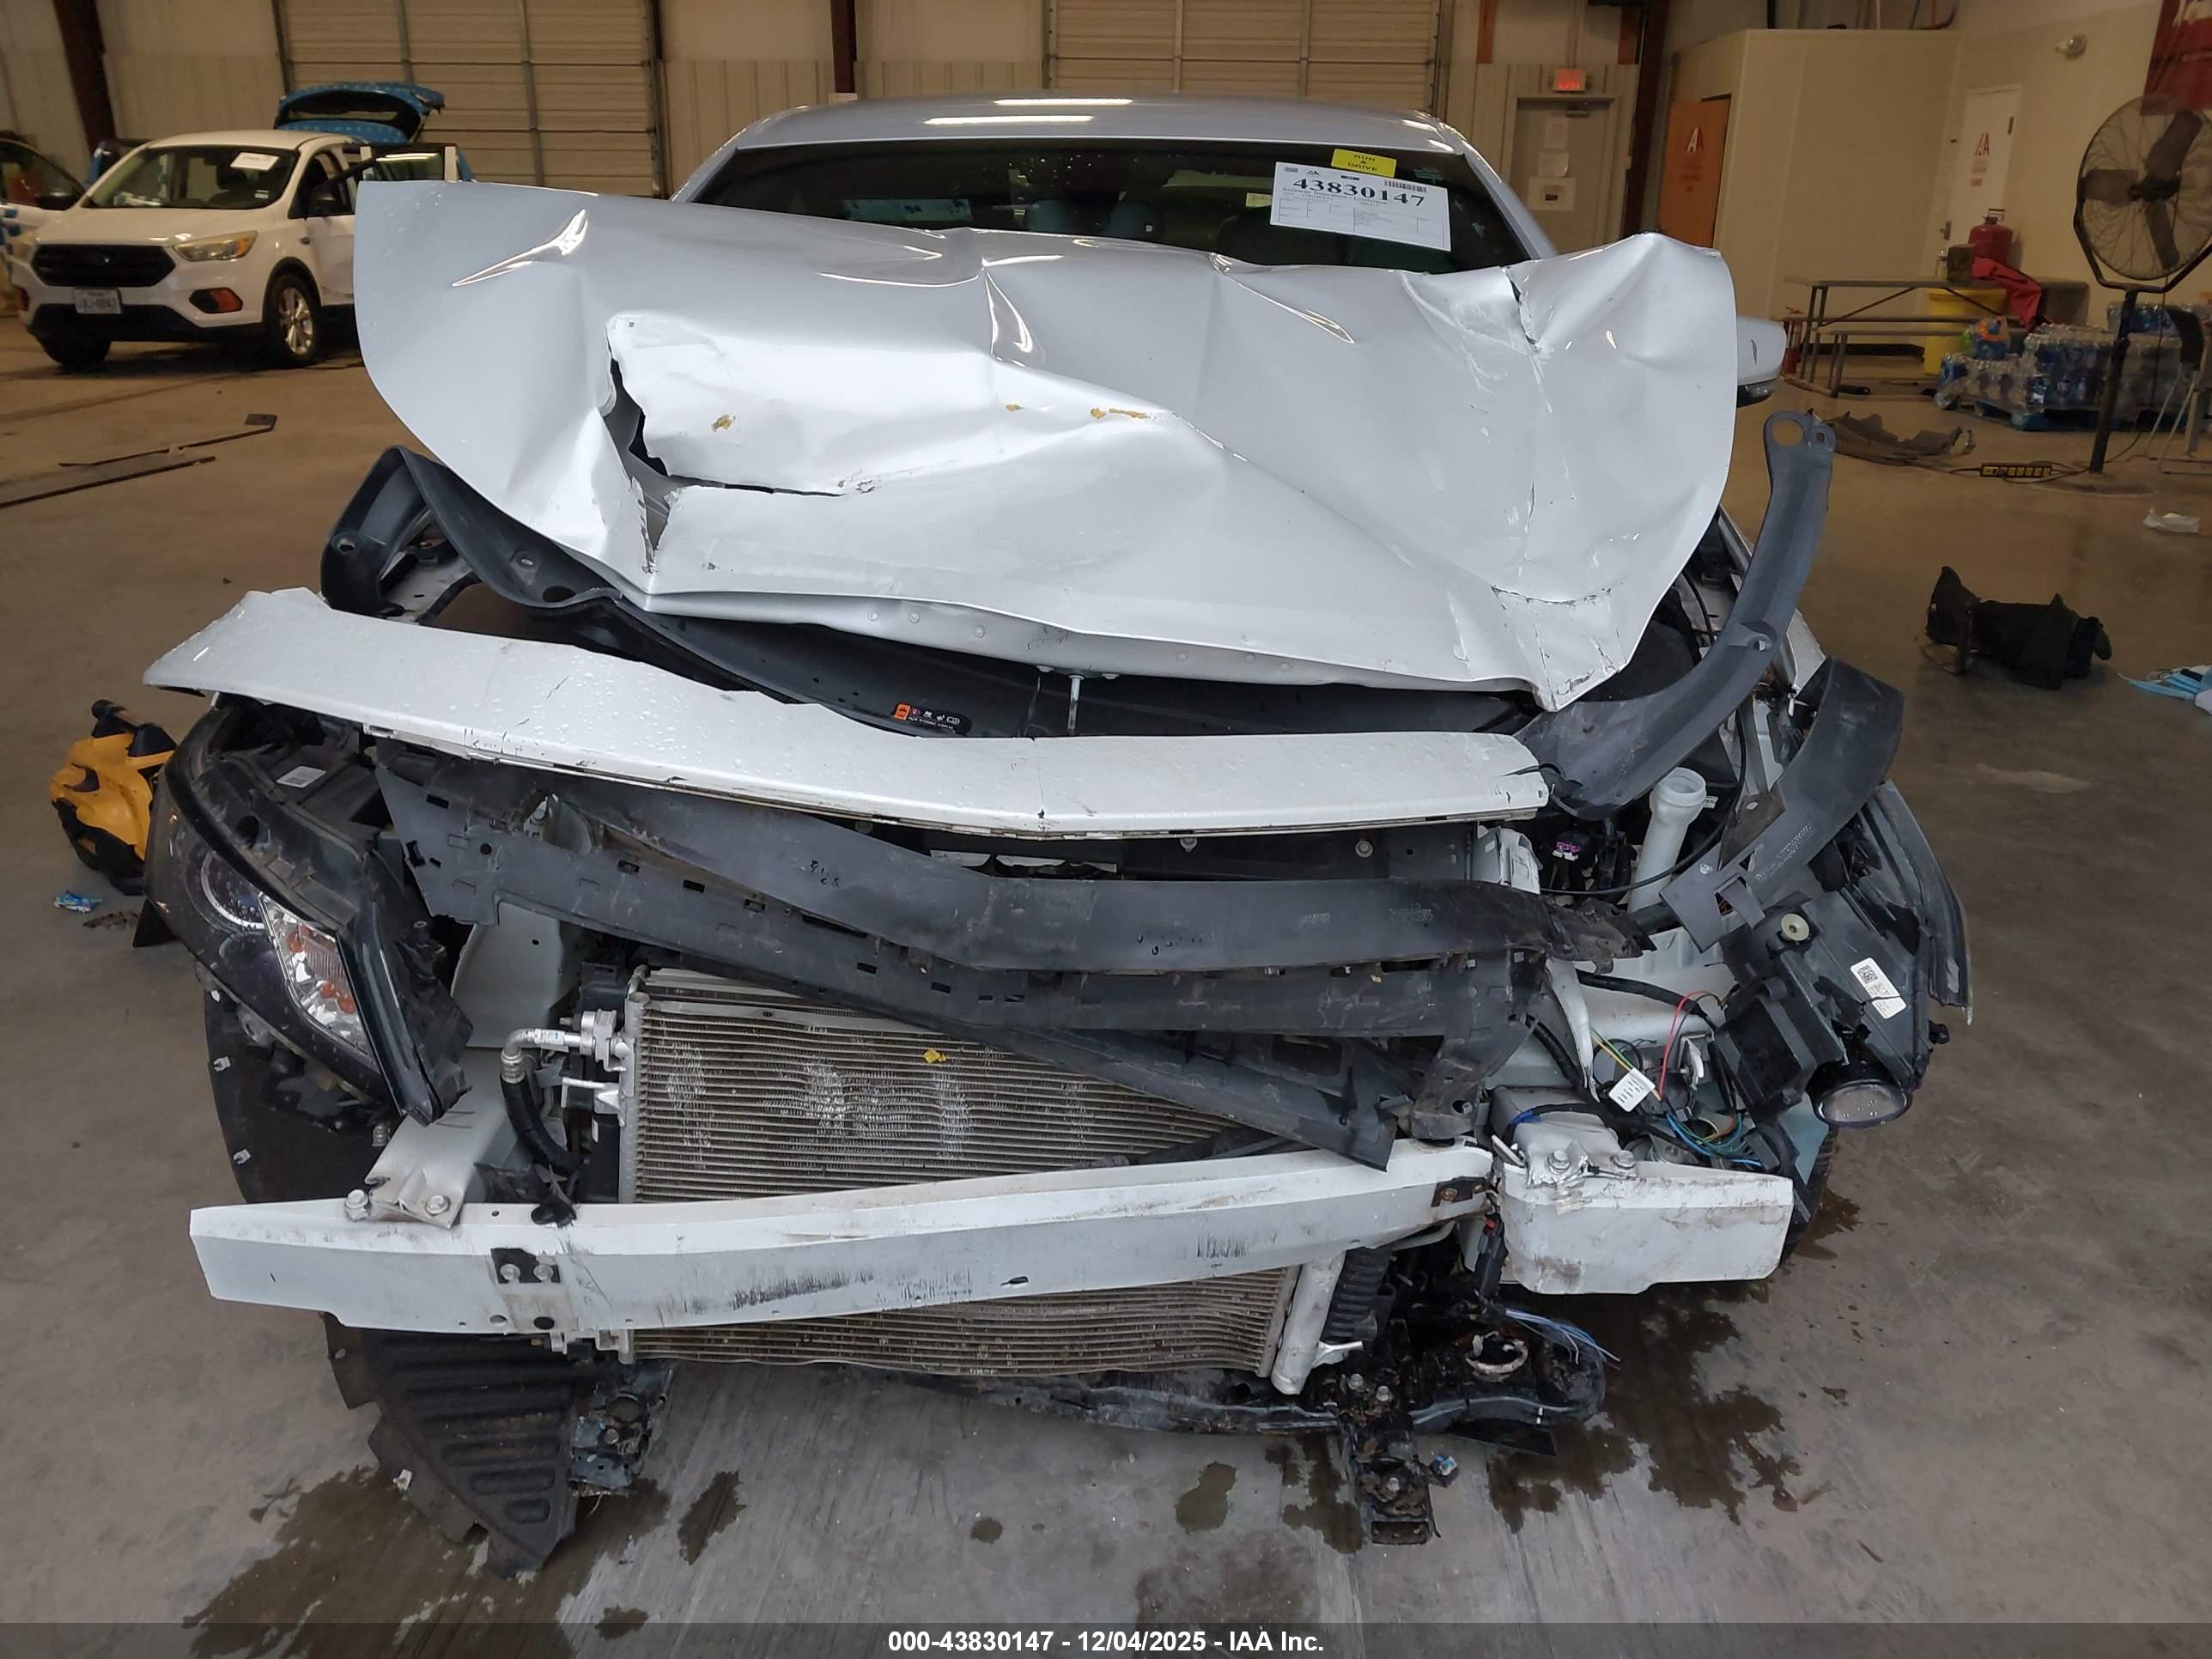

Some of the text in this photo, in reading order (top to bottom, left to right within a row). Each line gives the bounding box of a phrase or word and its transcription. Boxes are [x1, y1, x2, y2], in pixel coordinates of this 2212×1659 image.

[1353, 154, 1376, 162] RUN
[1347, 161, 1378, 172] DRIVE
[1292, 178, 1425, 207] 43830147
